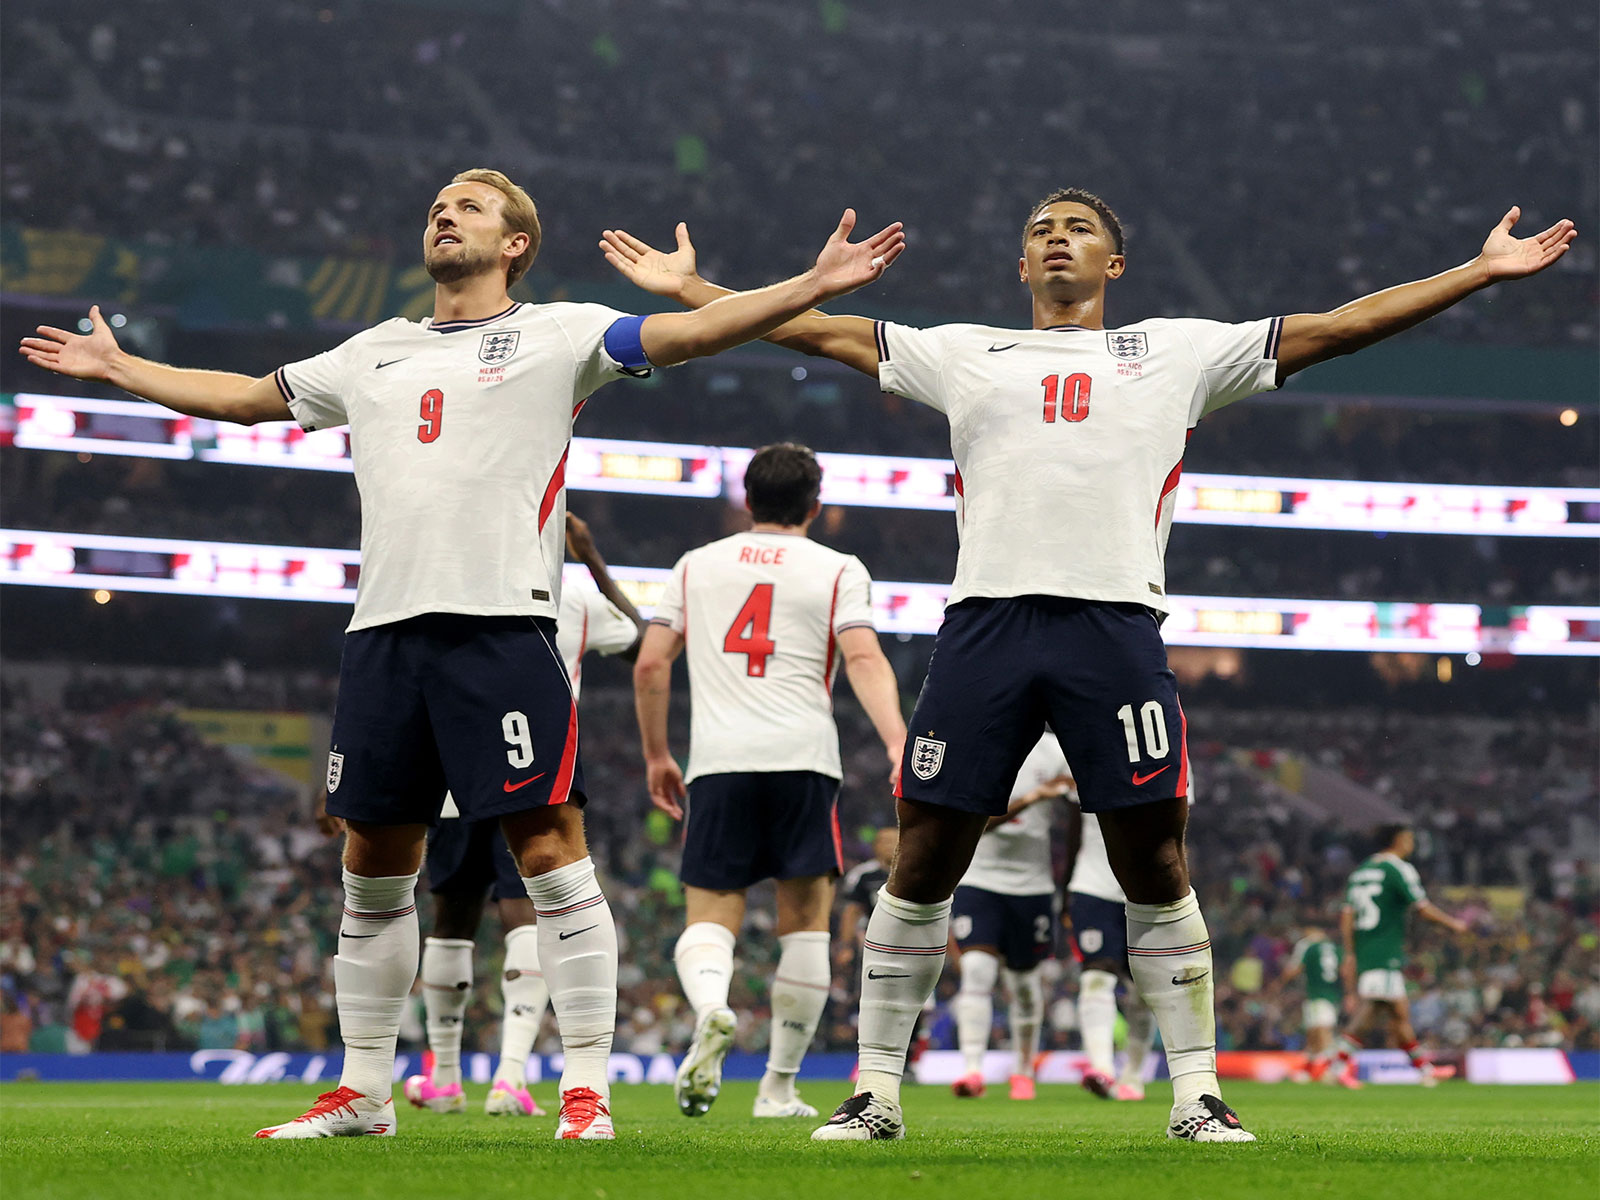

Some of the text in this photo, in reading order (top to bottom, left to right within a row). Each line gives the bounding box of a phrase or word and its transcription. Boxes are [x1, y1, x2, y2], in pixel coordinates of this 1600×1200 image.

[417, 388, 444, 444] 9
[1041, 372, 1092, 423] 10
[739, 545, 787, 566] RICE
[723, 583, 776, 678] 4
[501, 710, 535, 769] 9
[1117, 700, 1170, 763] 10
[1034, 914, 1050, 943] 2
